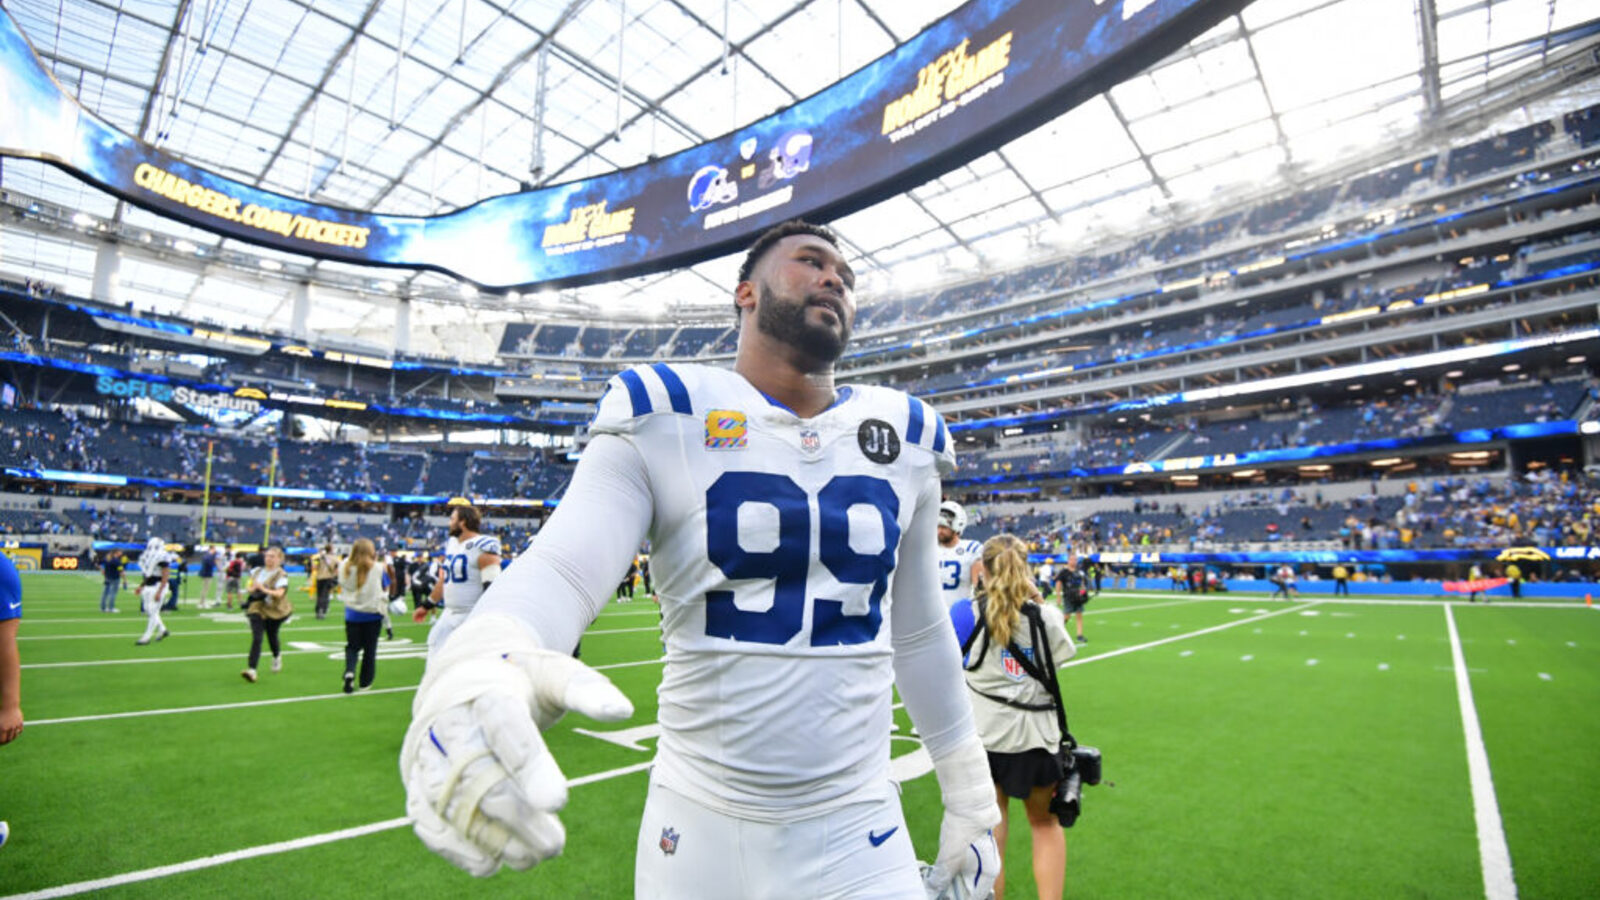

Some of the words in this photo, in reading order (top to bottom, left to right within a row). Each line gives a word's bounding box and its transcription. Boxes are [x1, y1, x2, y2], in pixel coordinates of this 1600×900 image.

[944, 31, 1013, 100] GAME
[133, 162, 371, 249] CHARGERS.COM/TICKETS
[173, 386, 261, 413] Stadium
[707, 410, 747, 438] C
[53, 556, 78, 570] 0:00
[704, 471, 902, 647] 99
[938, 560, 962, 590] 3
